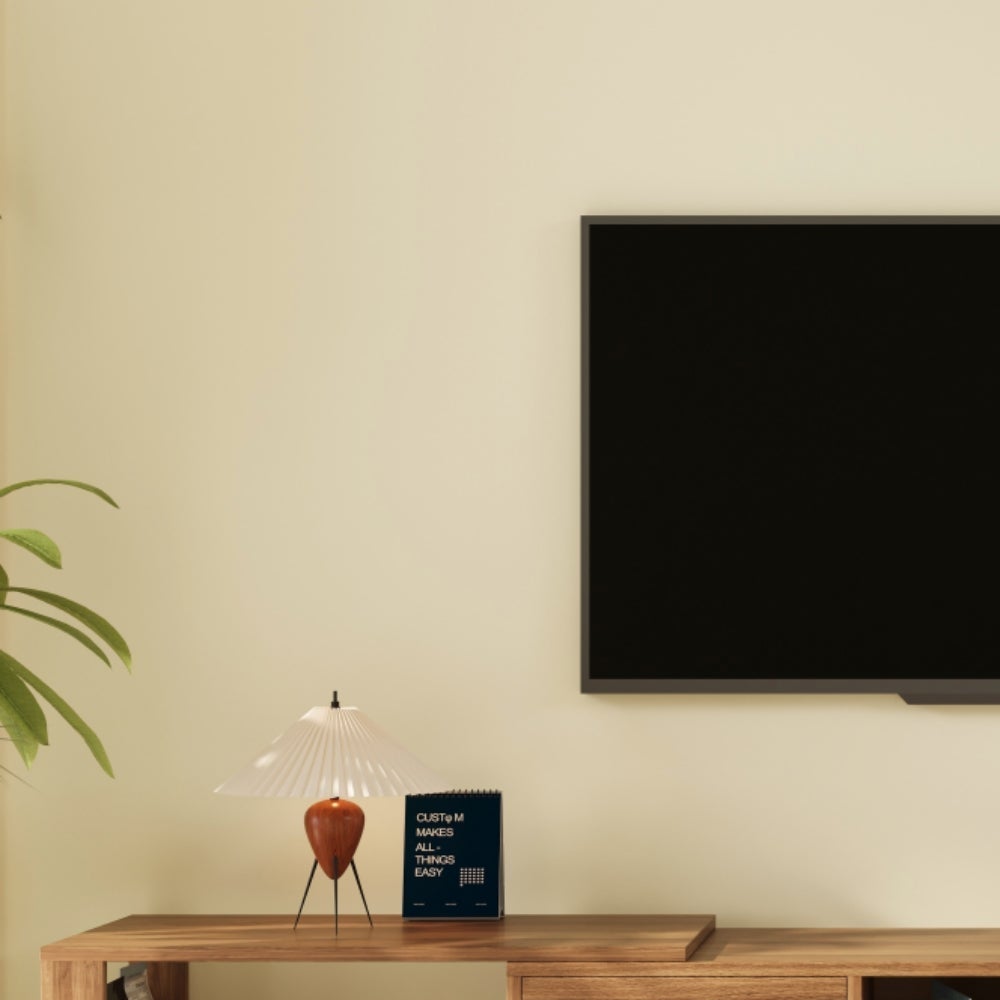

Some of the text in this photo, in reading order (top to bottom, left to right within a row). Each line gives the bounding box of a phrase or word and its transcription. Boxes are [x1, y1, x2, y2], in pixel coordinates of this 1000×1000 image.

[416, 828, 454, 837] MAKES
[415, 855, 455, 865] THINGS
[415, 868, 443, 877] EASY
